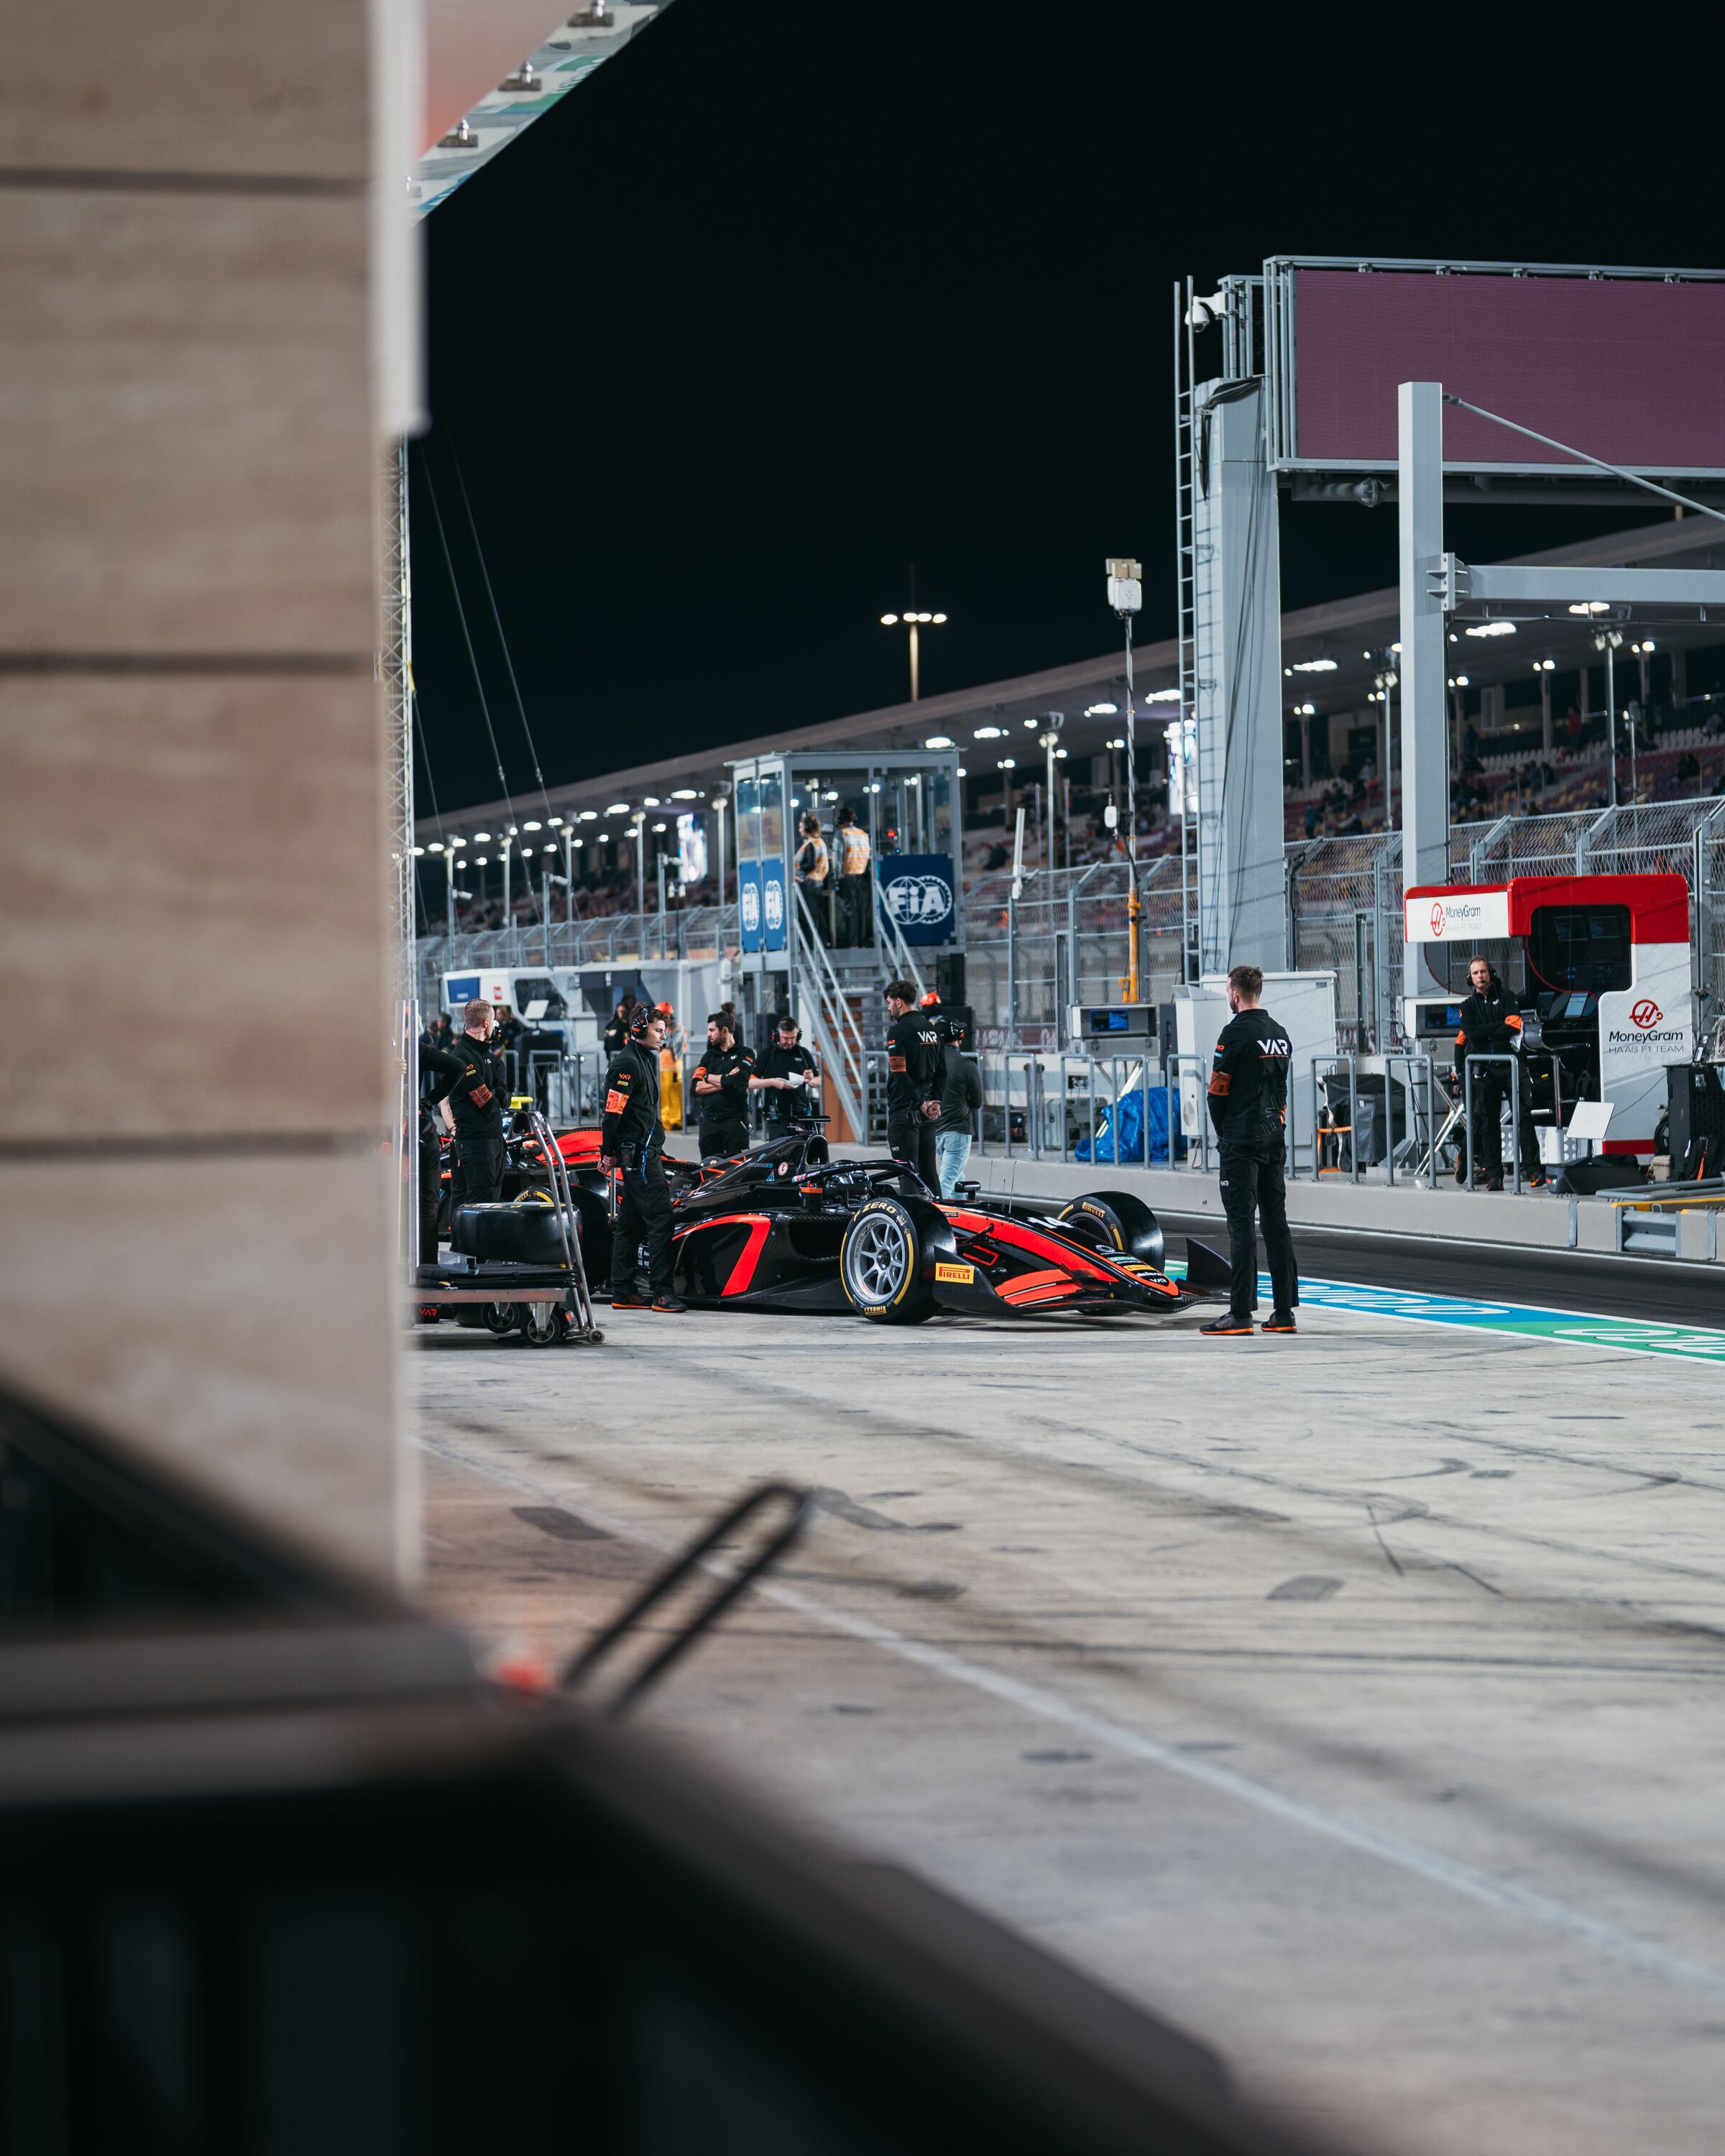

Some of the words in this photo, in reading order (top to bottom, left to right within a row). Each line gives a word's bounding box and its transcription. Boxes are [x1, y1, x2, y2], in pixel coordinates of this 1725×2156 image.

[1445, 904, 1481, 921] MoneyGram
[916, 1031, 937, 1043] VAR
[1609, 1029, 1683, 1044] MoneyGram
[1256, 1038, 1288, 1055] VAR
[619, 1072, 631, 1081] VAR
[862, 1201, 897, 1215] ZERO
[1082, 1202, 1105, 1218] PIRELLI
[939, 1266, 970, 1280] PIRELLI
[418, 1307, 438, 1317] VAR
[864, 1305, 887, 1315] PIRELLI
